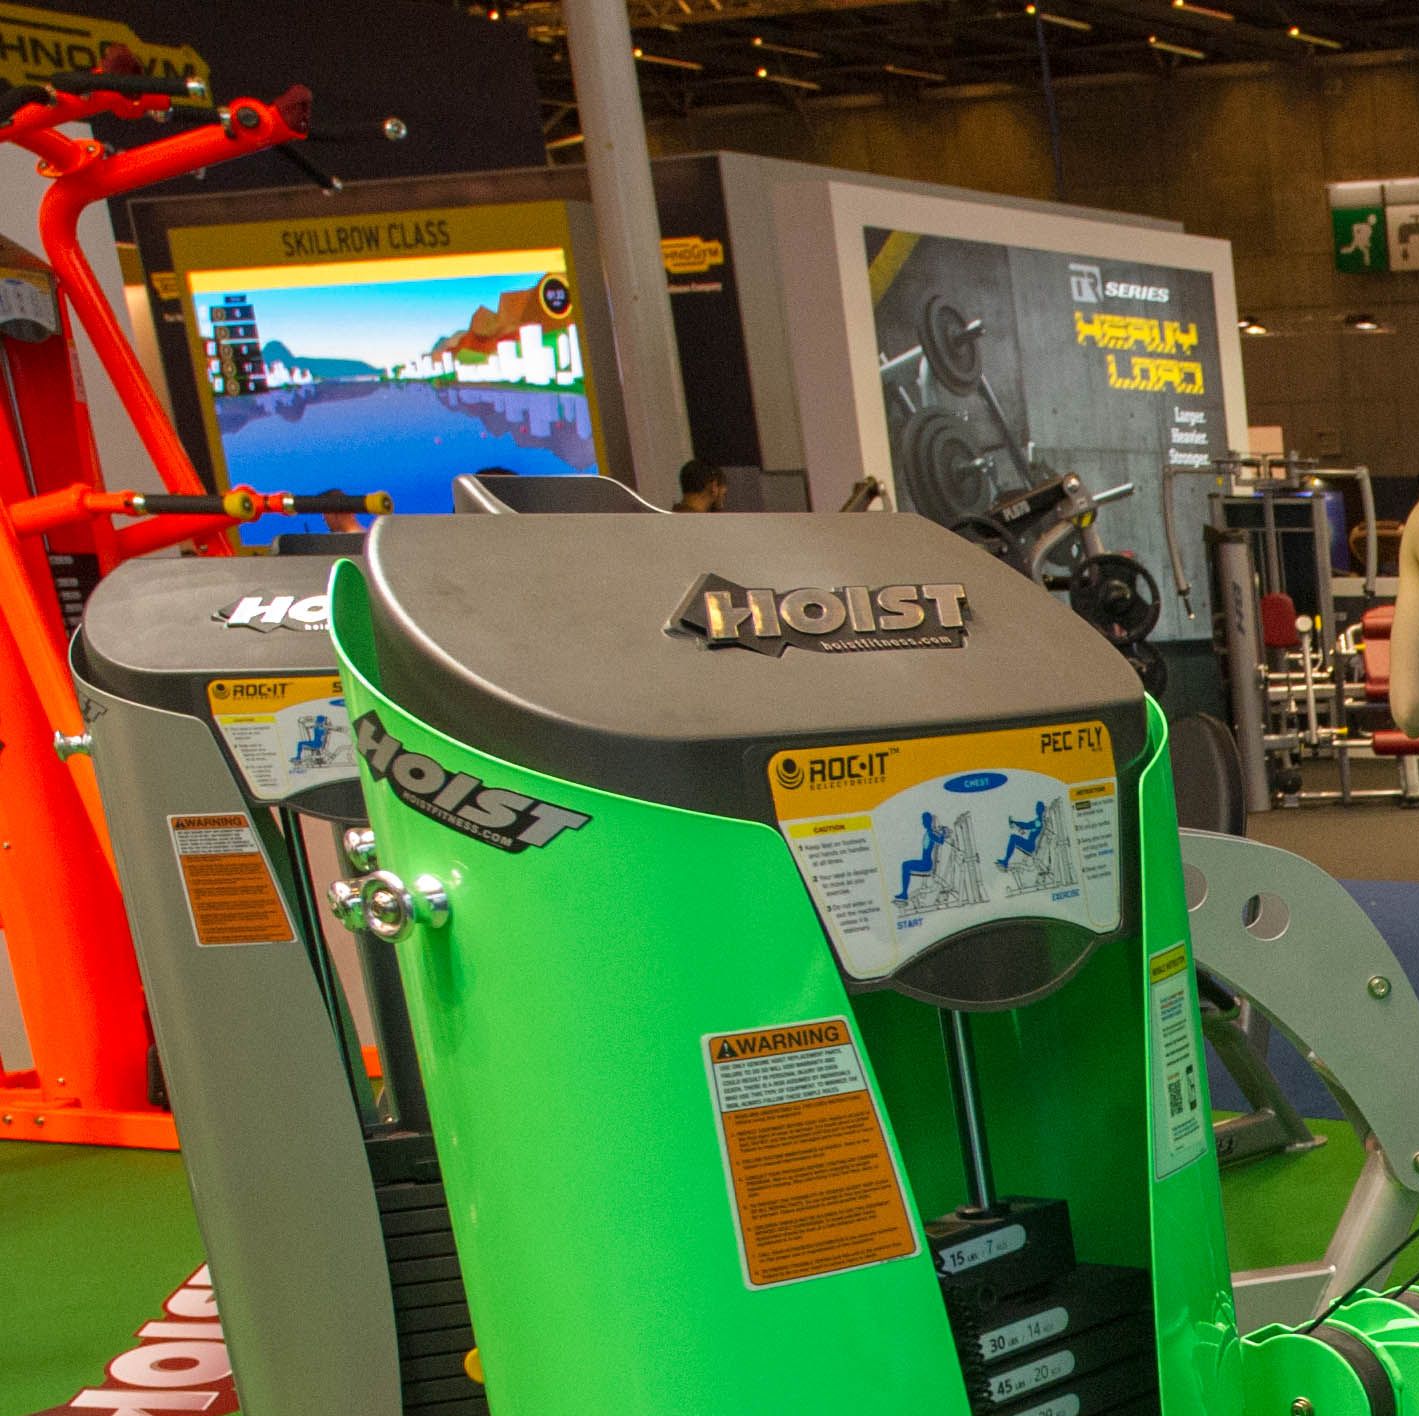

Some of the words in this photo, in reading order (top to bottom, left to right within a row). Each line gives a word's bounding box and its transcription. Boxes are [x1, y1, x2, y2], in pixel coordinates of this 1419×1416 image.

[282, 225, 379, 256] SKILLROW
[388, 219, 450, 249] CLASS
[1105, 281, 1169, 302] SERIES
[1074, 311, 1198, 355] HEAVY
[1106, 354, 1204, 394] LOAD
[704, 583, 965, 640] HOIST
[821, 635, 952, 652] hoistfitness.com
[1041, 731, 1073, 754] PEC
[1078, 727, 1102, 748] FLY
[357, 718, 592, 848] HOIST
[402, 790, 513, 847] HOISTFITNESS.COM
[897, 918, 924, 930] START
[735, 1025, 840, 1054] WARNING
[950, 1251, 965, 1267] 15
[986, 1240, 993, 1253] 7
[989, 1336, 1006, 1353] 30
[1028, 1322, 1041, 1337] 14
[997, 1379, 1013, 1395] 45
[1034, 1365, 1049, 1382] 20
